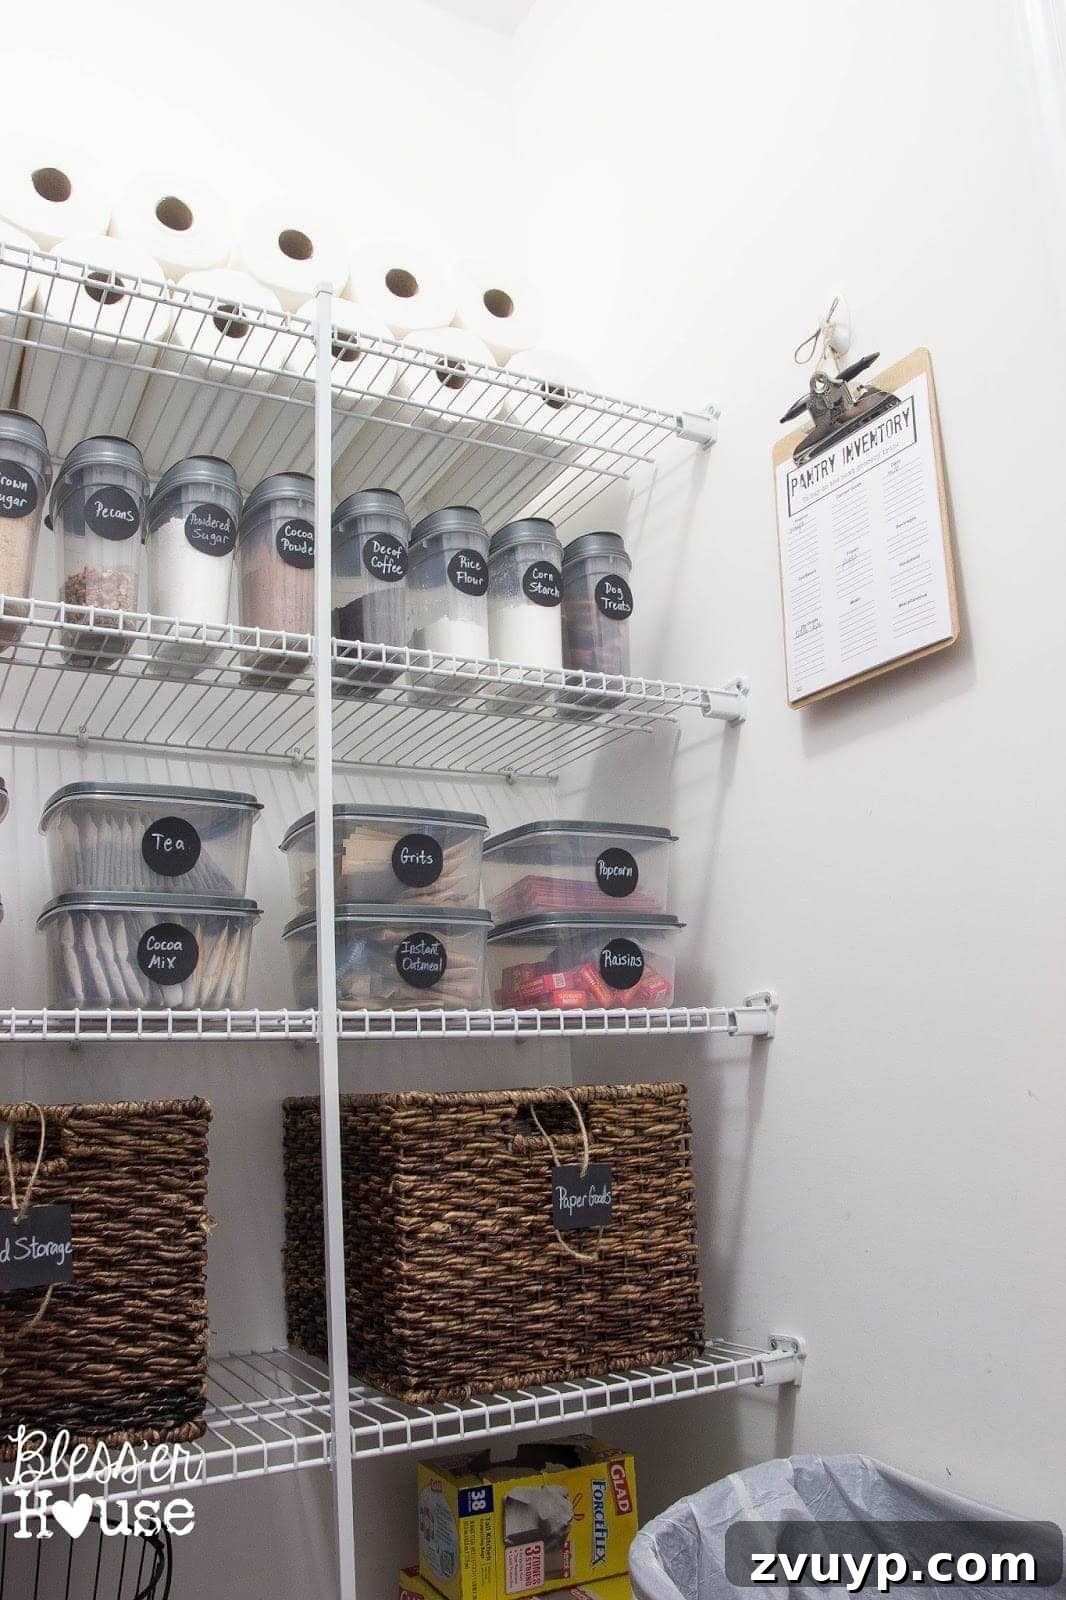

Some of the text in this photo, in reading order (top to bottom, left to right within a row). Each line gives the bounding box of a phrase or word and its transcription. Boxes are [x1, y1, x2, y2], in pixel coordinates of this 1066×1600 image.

[791, 454, 835, 497] PANTRY
[843, 407, 910, 464] INVENTORY
[0, 473, 27, 492] rown
[0, 494, 27, 509] ugar
[94, 501, 135, 523] Pecans
[189, 512, 231, 532] Powdered
[192, 529, 229, 546] Sugar
[284, 525, 314, 541] Cocoa
[280, 537, 313, 556] Powde
[372, 540, 404, 559] Decaf
[371, 556, 404, 576] Coffee
[459, 556, 481, 571] Rice
[456, 571, 484, 586] Flour
[532, 568, 554, 581] Corn
[529, 581, 560, 598] Starch
[604, 582, 623, 601] Dog
[602, 596, 631, 612] Treats
[151, 833, 185, 852] Tea
[400, 847, 434, 866] Grits
[597, 859, 633, 879] Popcorn
[146, 936, 184, 951] Cocoa
[401, 941, 440, 955] Instant
[402, 957, 443, 973] Oatmeal
[602, 949, 642, 968] Raisins
[555, 1184, 611, 1217] Paper Goods
[13, 1235, 73, 1266] Storage
[610, 1463, 629, 1512] GLAD
[471, 1489, 486, 1511] 38
[525, 1545, 541, 1556] 3
[532, 1557, 541, 1585] ZONES
